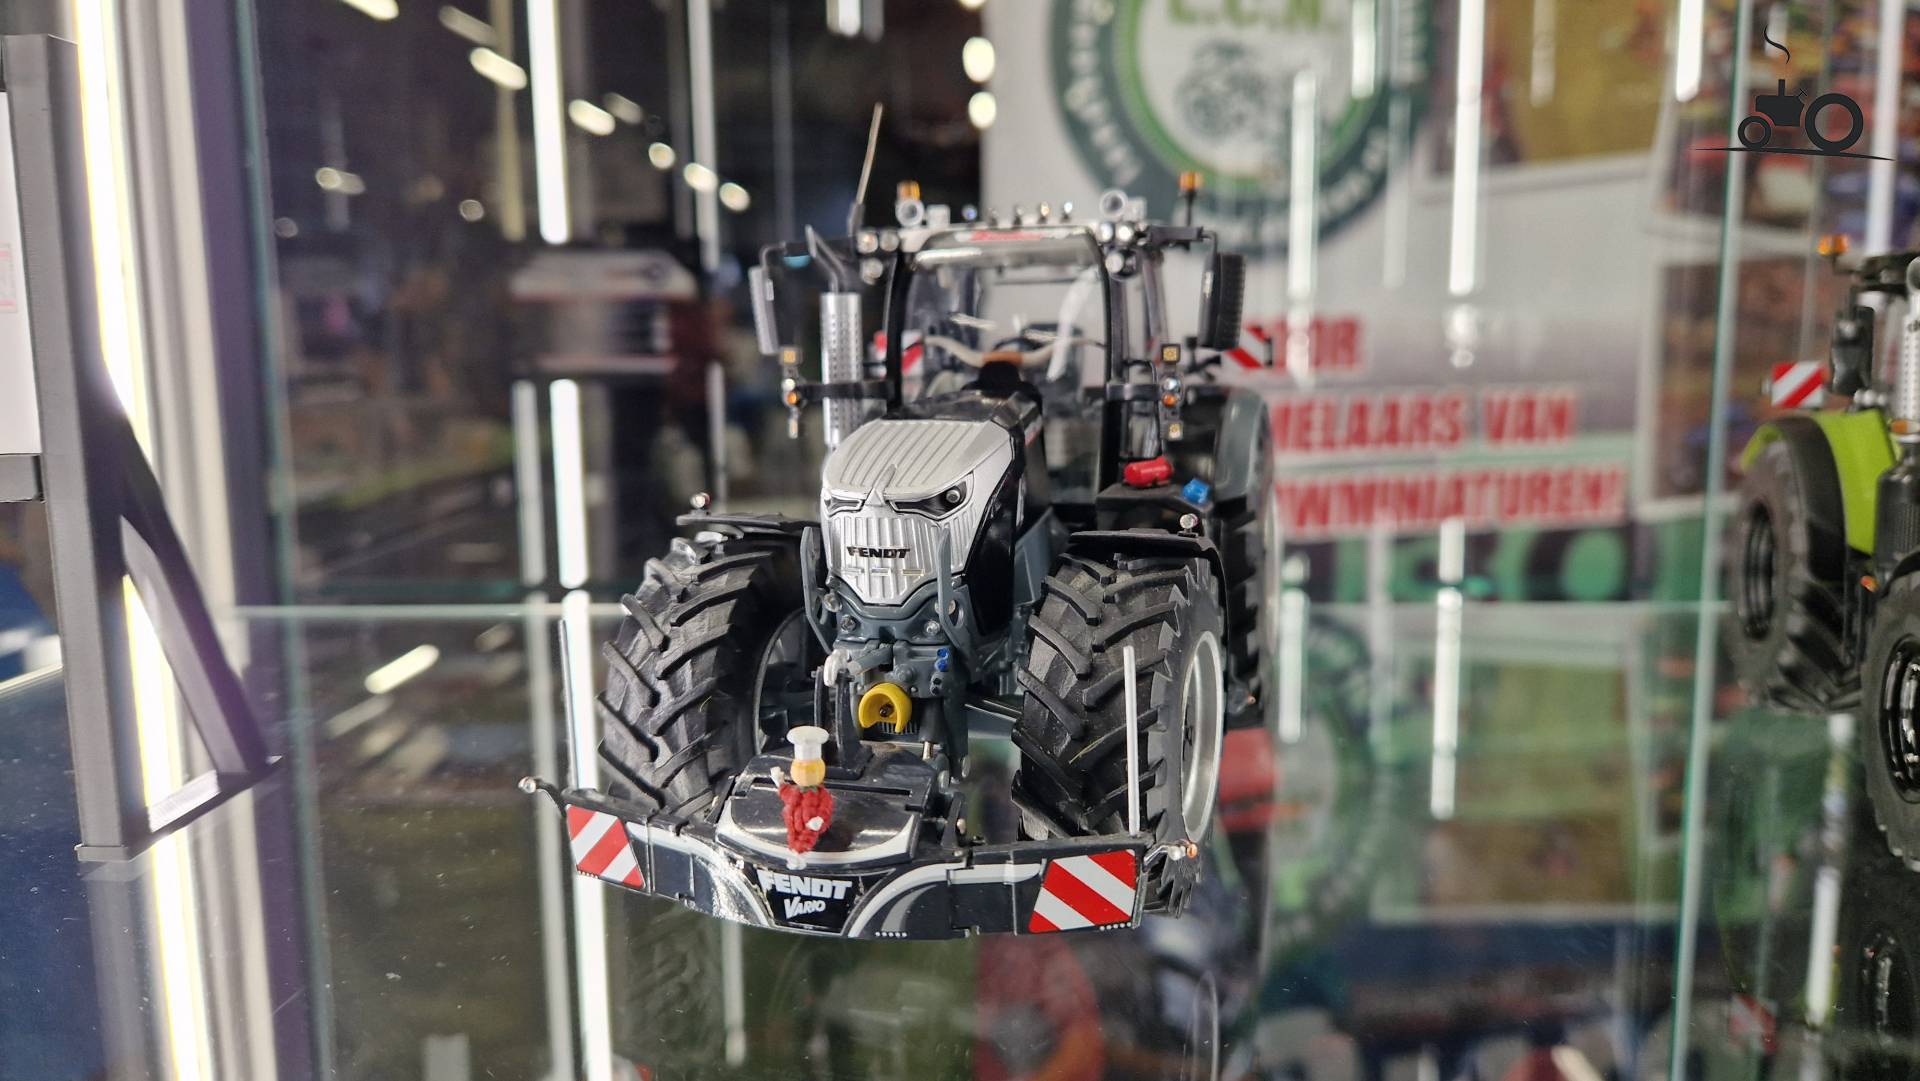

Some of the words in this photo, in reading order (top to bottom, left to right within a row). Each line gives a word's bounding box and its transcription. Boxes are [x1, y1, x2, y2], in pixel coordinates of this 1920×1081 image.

[1483, 390, 1574, 443] VAN
[846, 546, 911, 559] FENDT
[756, 869, 853, 899] FENDT
